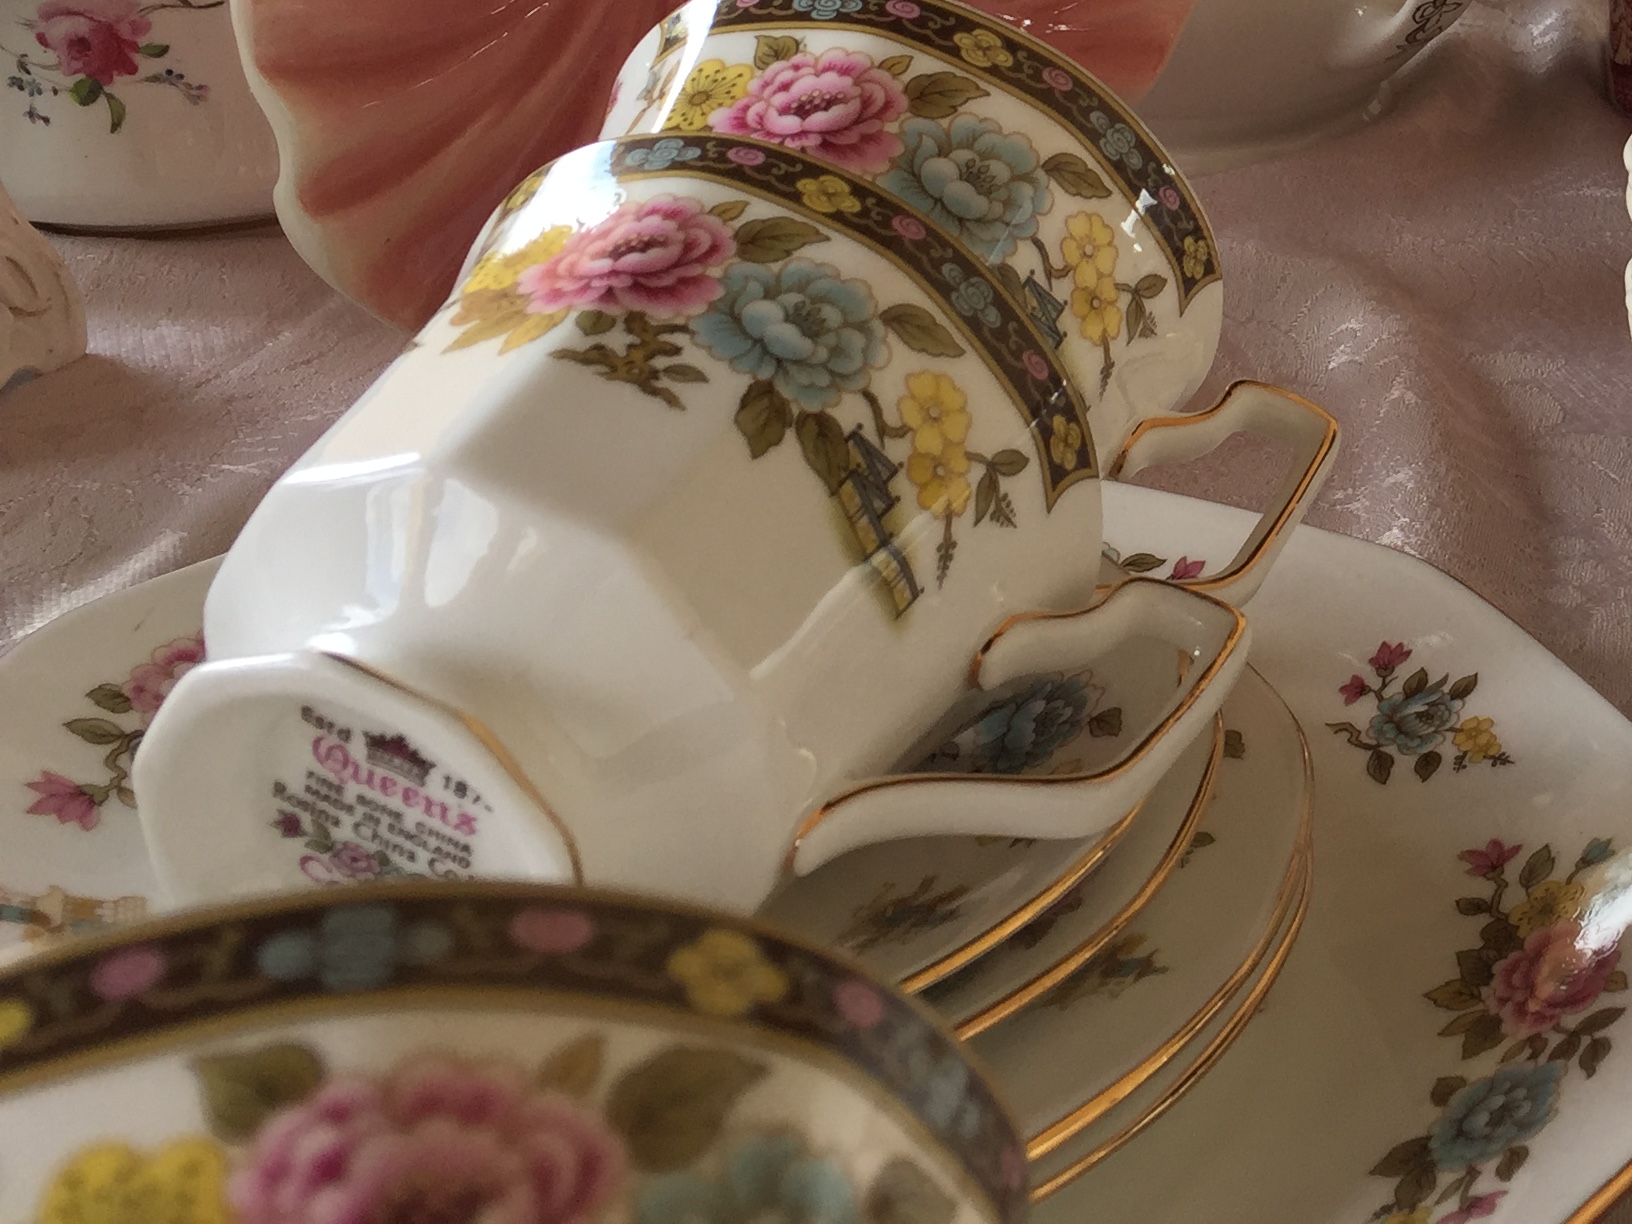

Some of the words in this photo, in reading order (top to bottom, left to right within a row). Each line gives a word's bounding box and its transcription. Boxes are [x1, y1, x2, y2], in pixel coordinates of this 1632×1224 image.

[305, 784, 355, 815] MADE
[387, 823, 471, 869] ENGLAND
[306, 769, 344, 794] FINE
[356, 793, 404, 822] BONE
[415, 821, 472, 857] CHINA
[352, 822, 416, 863] China
